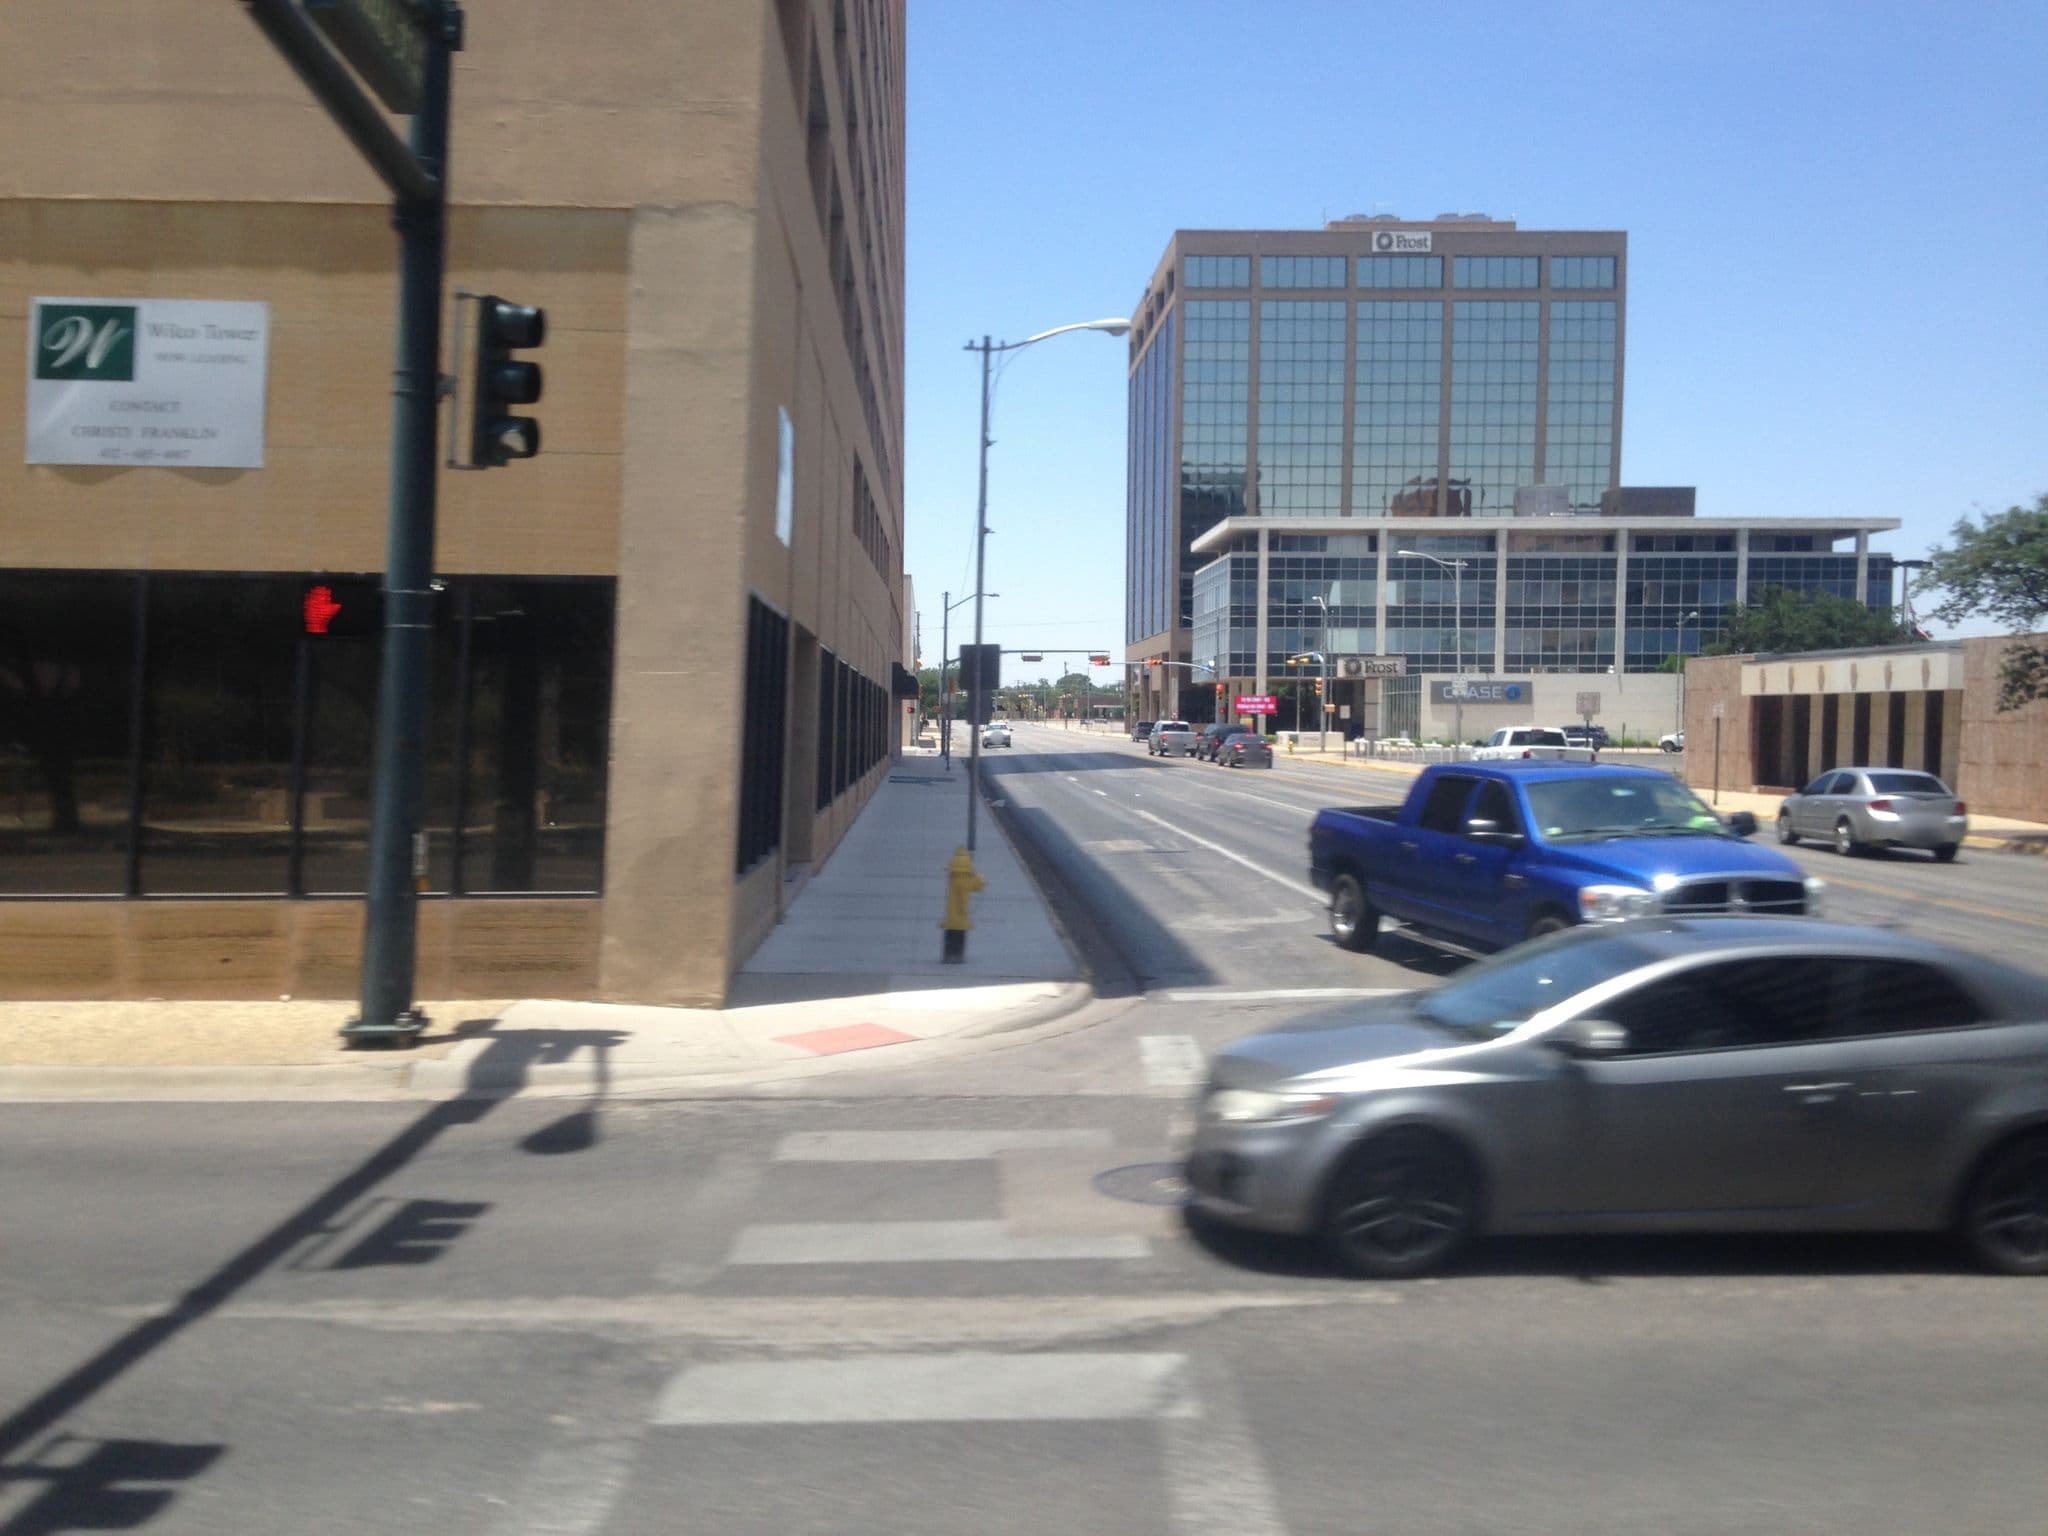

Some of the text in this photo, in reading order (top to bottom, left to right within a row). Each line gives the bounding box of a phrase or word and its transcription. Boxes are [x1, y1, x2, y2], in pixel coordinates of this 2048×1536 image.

[1395, 235, 1428, 249] Frost
[203, 323, 259, 341] Tower
[109, 400, 181, 413] CONTACT
[140, 426, 218, 440] FRANKLIN
[1364, 660, 1398, 674] Frost
